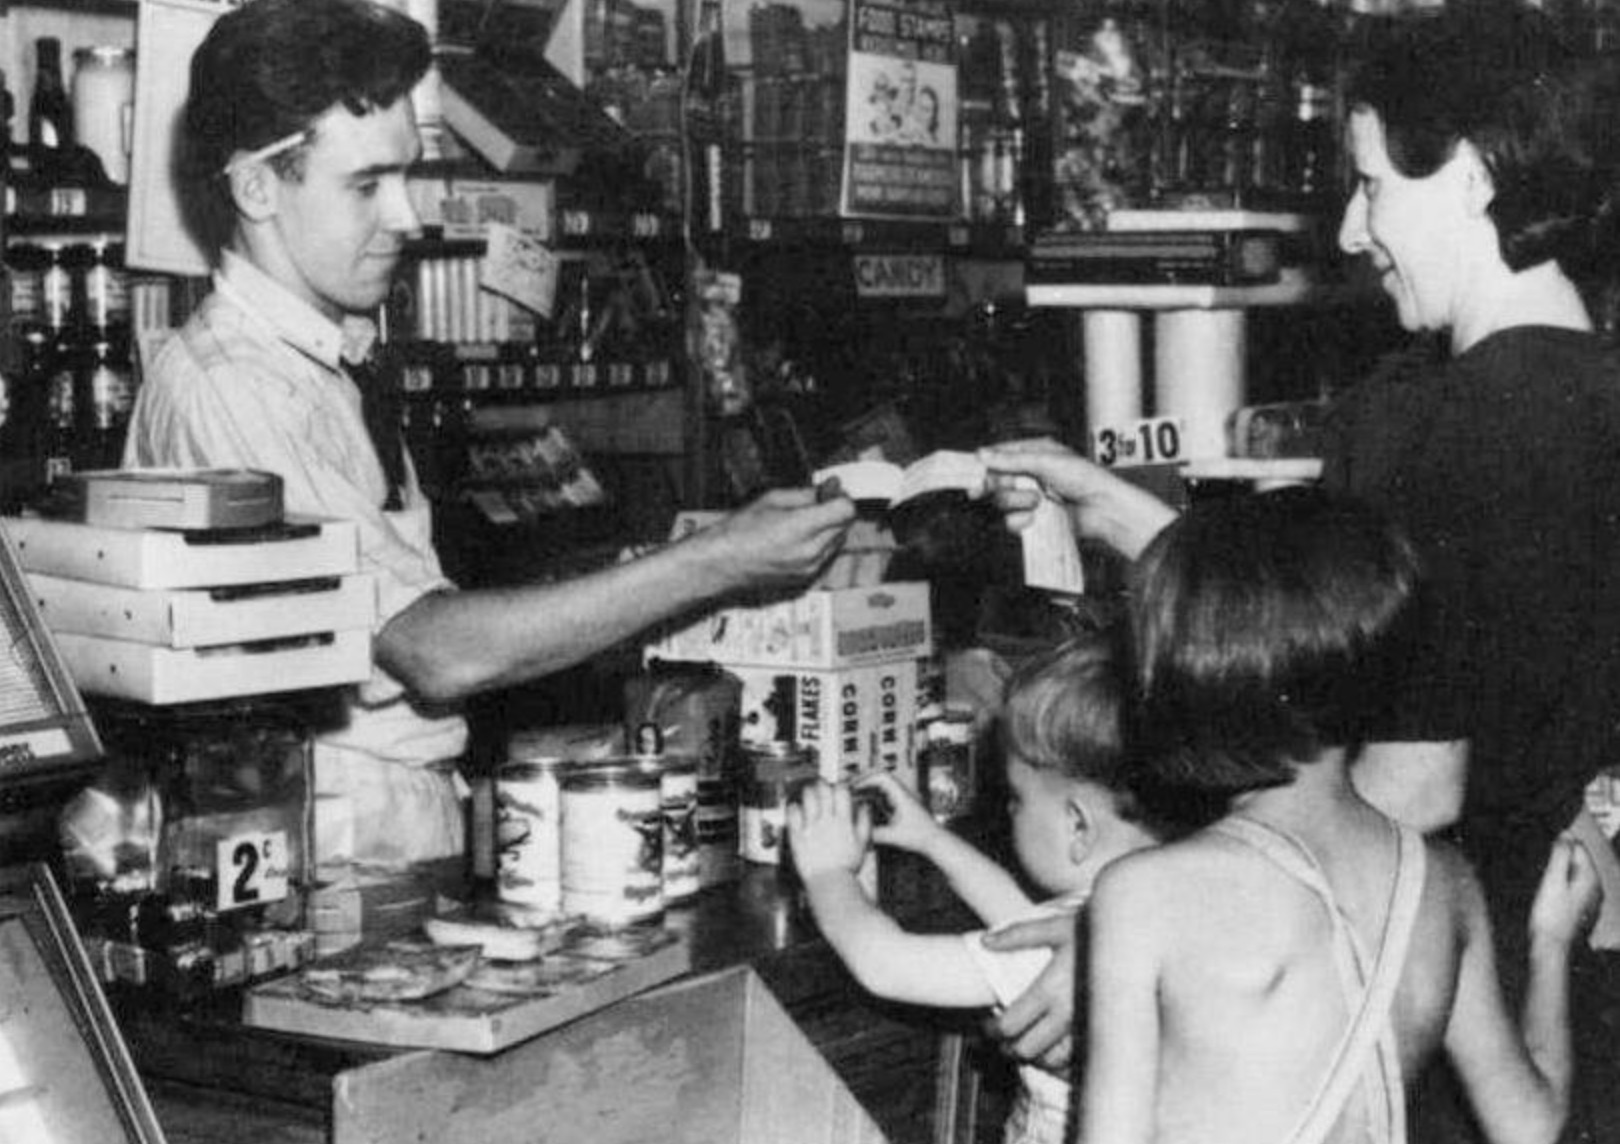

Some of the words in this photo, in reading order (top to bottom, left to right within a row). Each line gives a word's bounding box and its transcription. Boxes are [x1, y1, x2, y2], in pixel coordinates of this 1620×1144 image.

[858, 258, 942, 289] CANDY
[801, 675, 821, 741] FLAKES
[842, 682, 860, 753] CORN
[880, 675, 897, 743] CORN
